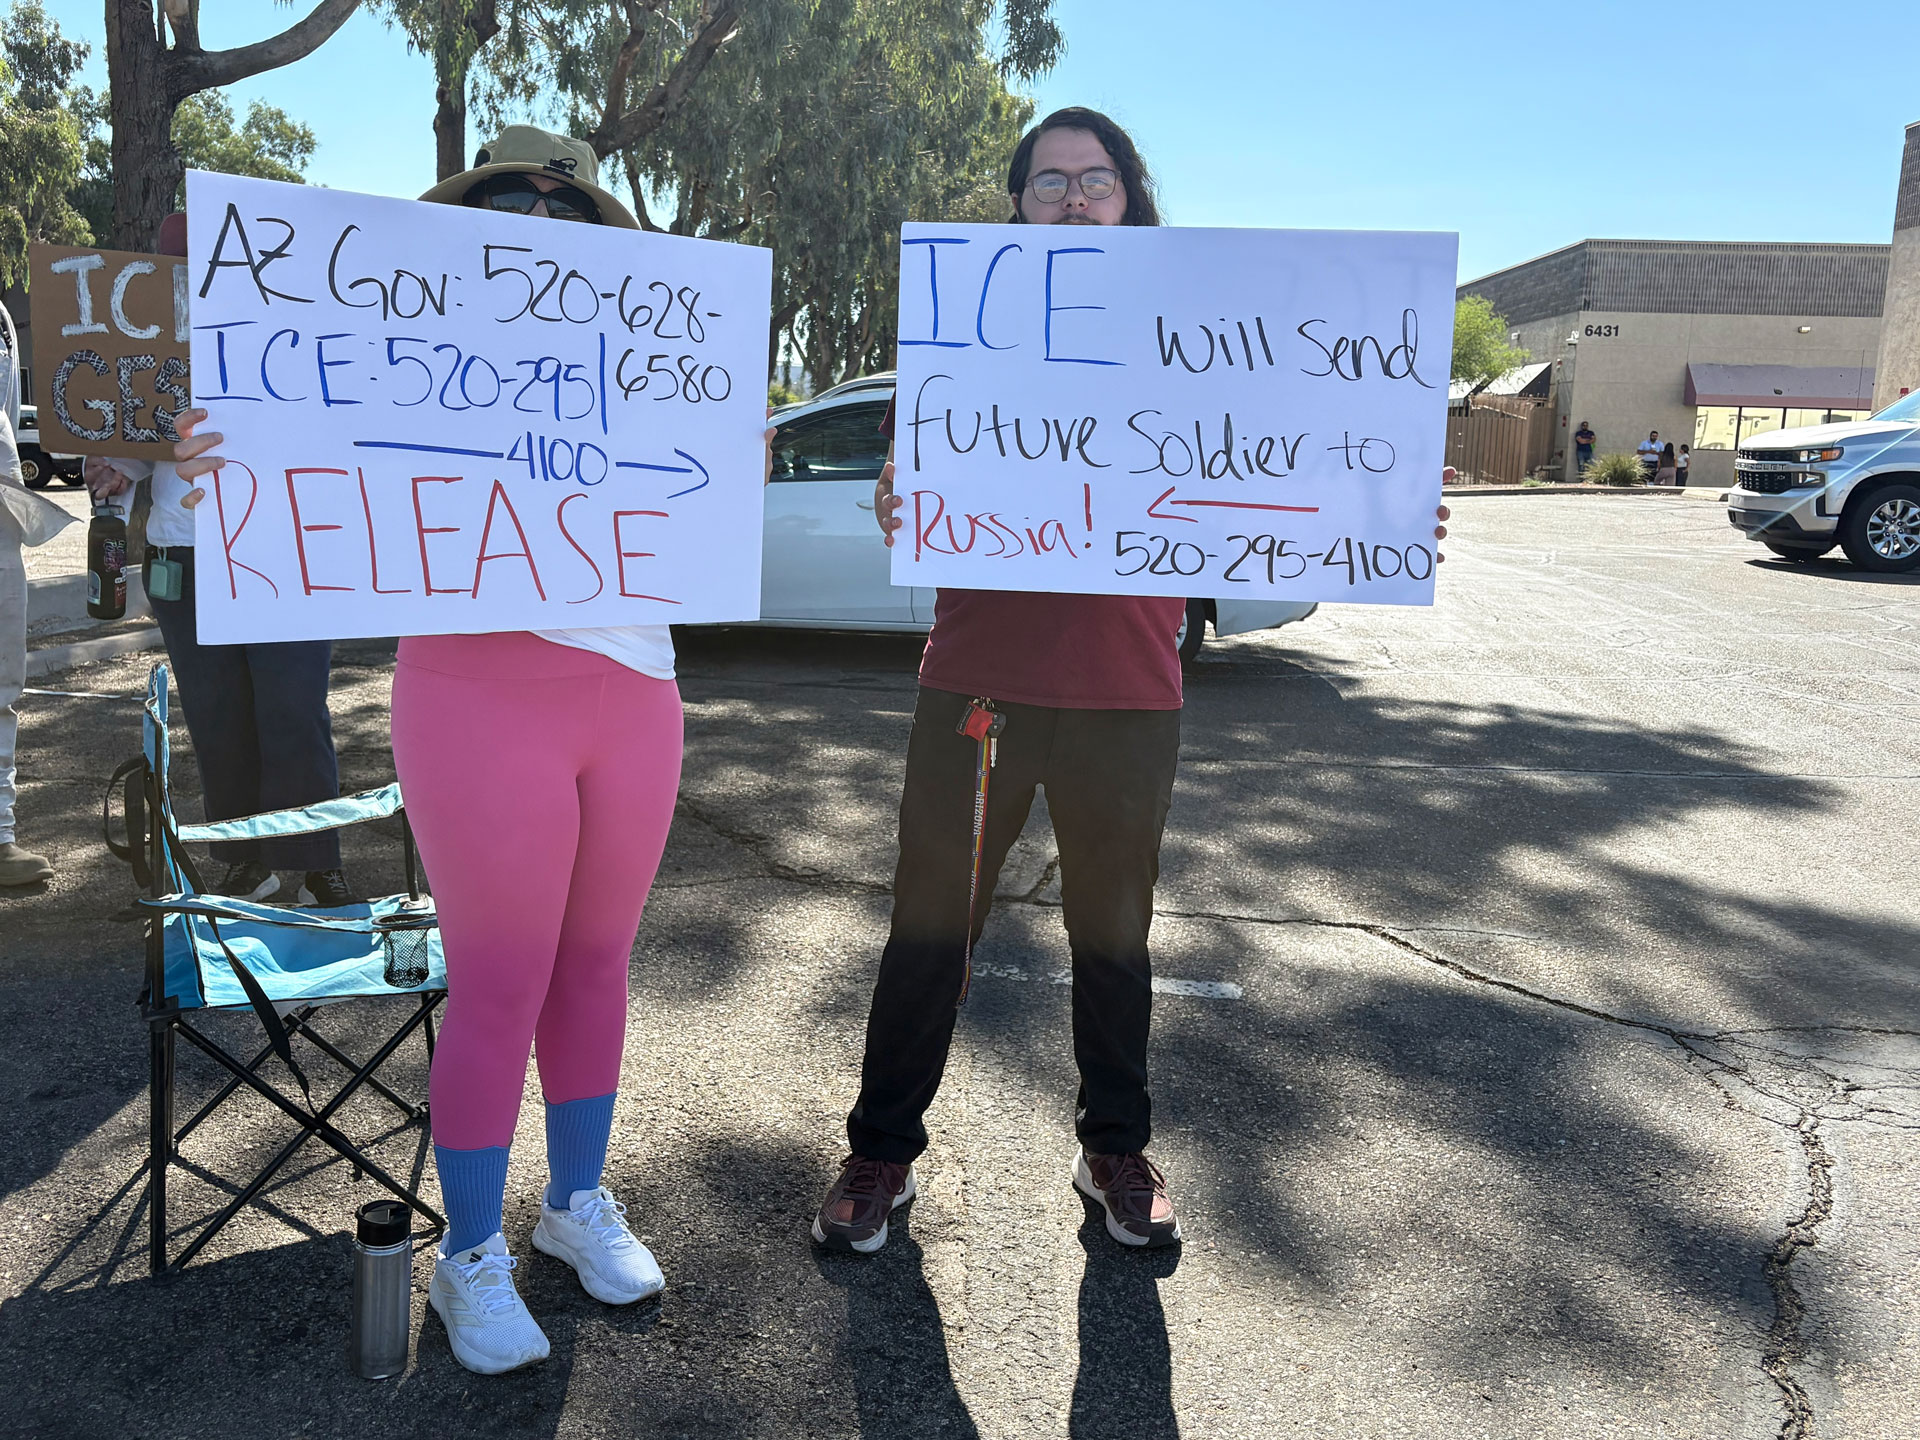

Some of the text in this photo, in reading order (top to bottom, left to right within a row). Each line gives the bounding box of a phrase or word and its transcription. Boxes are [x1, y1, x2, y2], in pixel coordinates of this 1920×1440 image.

[199, 203, 315, 306] AZ
[483, 244, 722, 343] 520-628-
[899, 237, 1126, 366] ICE
[1297, 309, 1437, 389] Send
[1584, 324, 1619, 337] 6431
[52, 349, 191, 444] GES
[616, 348, 731, 404] 6580
[507, 431, 608, 486] 4100
[1327, 432, 1396, 473] to
[211, 460, 682, 604] RELEASE
[911, 484, 1433, 586] Russia! 520-295-4100
[973, 790, 985, 836] ARIZONA
